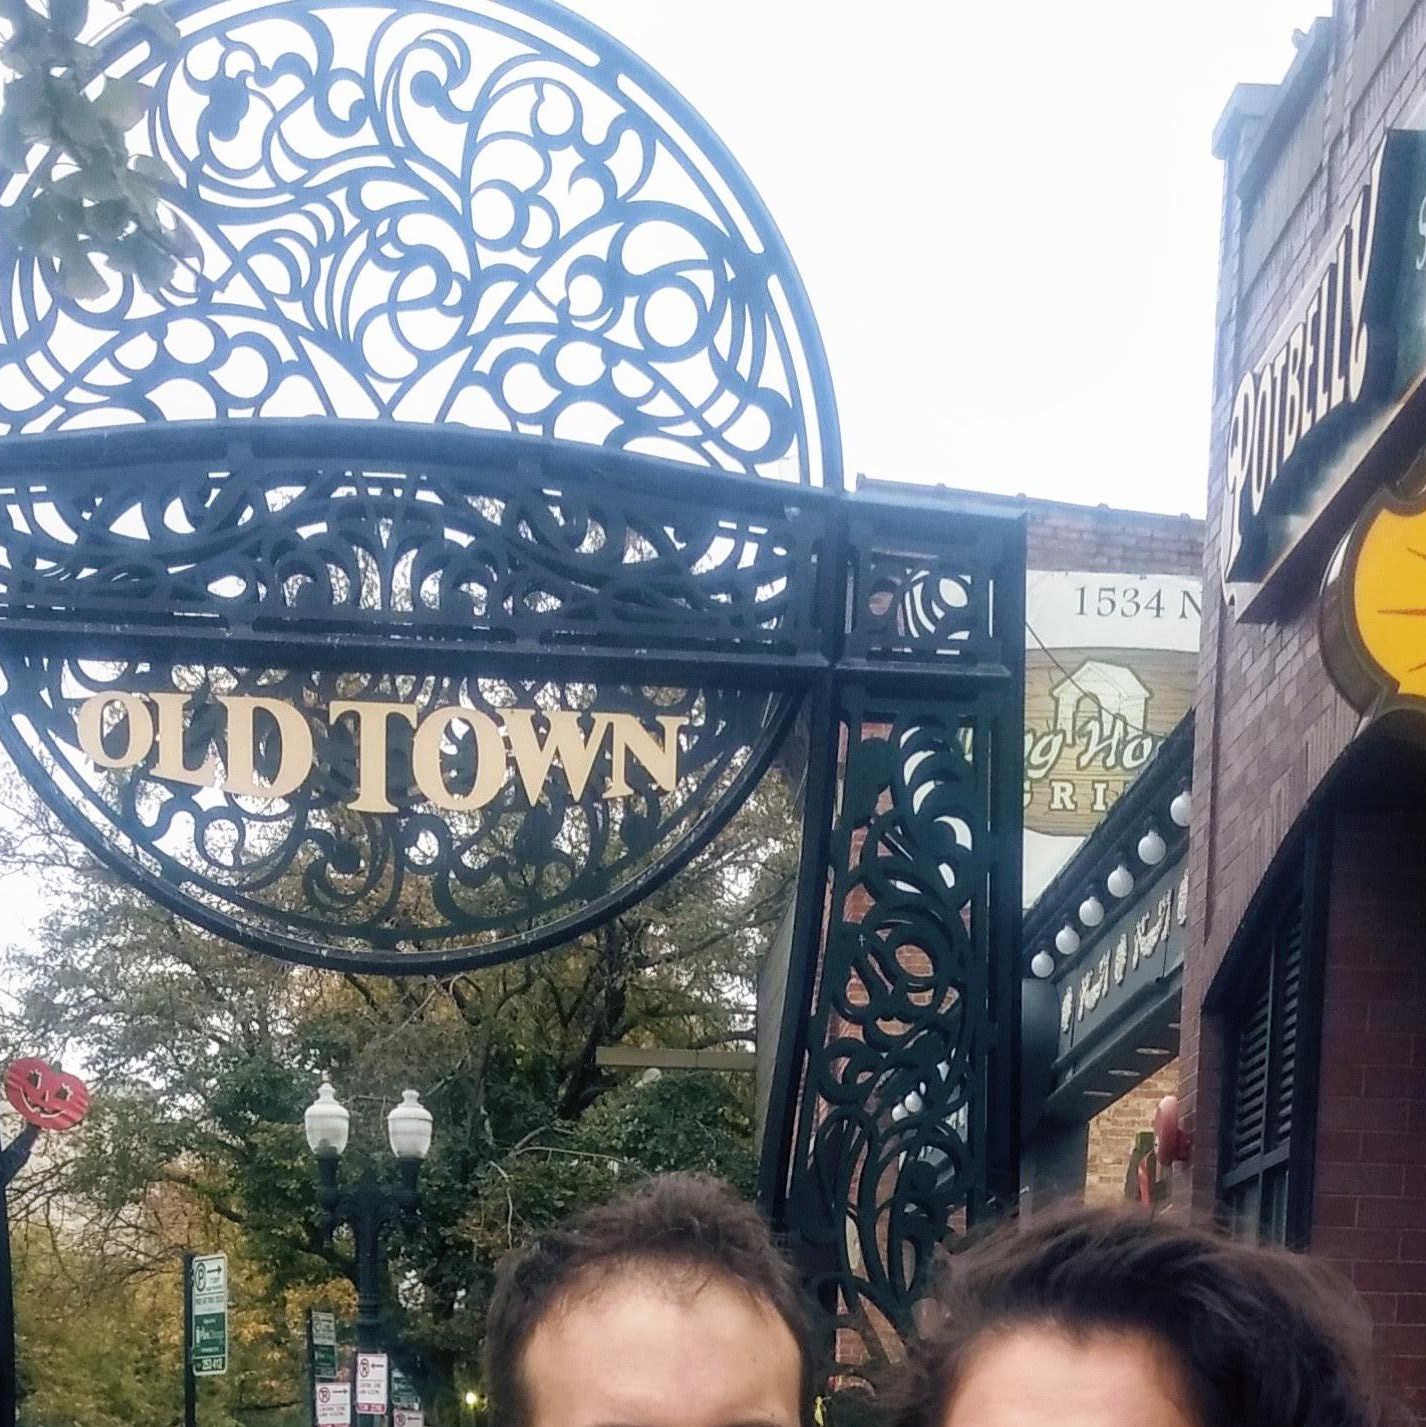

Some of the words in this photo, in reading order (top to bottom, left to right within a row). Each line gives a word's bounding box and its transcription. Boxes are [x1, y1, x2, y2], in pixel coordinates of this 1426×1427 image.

[1223, 130, 1384, 582] POTBELLY
[1075, 585, 1166, 619] 1534
[1178, 589, 1202, 620] N
[76, 689, 314, 800] OLD
[328, 699, 690, 814] TOWN
[1076, 716, 1164, 770] Ho
